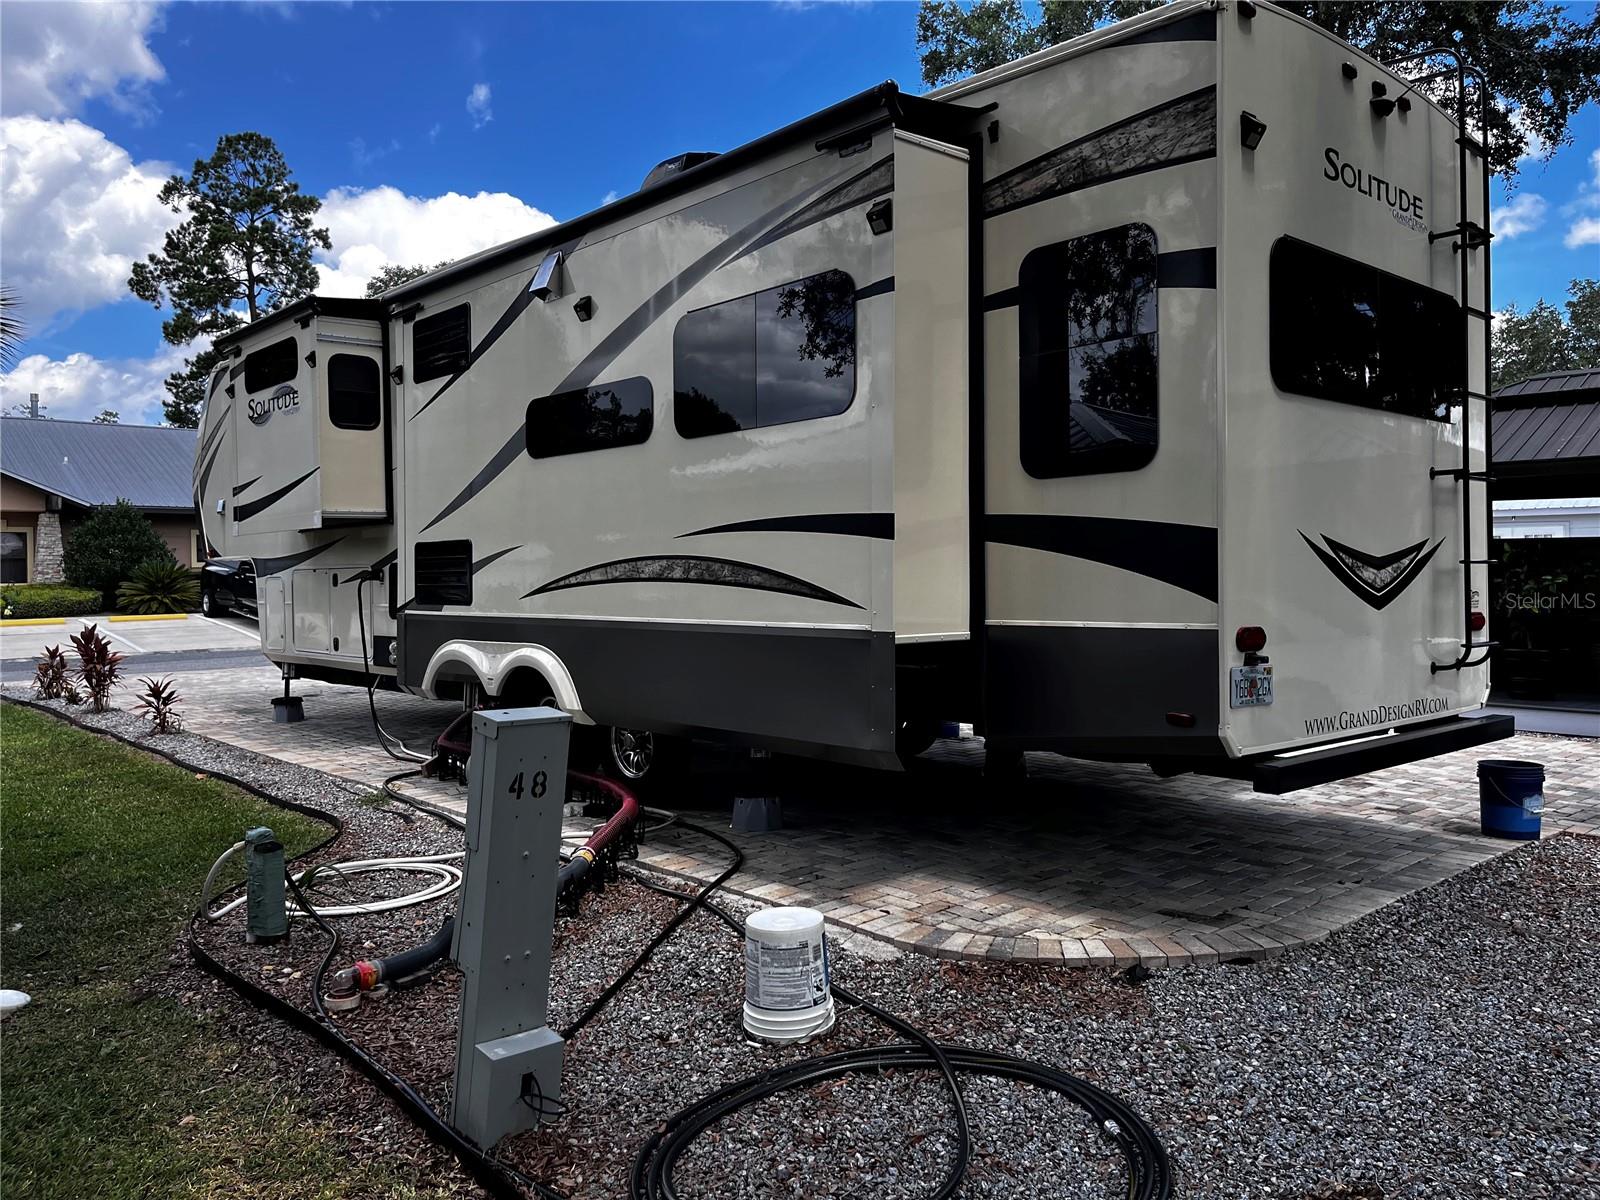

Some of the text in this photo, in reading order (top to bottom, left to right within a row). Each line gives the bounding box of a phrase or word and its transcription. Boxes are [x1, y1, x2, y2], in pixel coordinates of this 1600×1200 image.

[1323, 147, 1424, 220] SOLITUDE
[248, 390, 299, 419] SOLITUDE
[508, 770, 548, 800] 48
